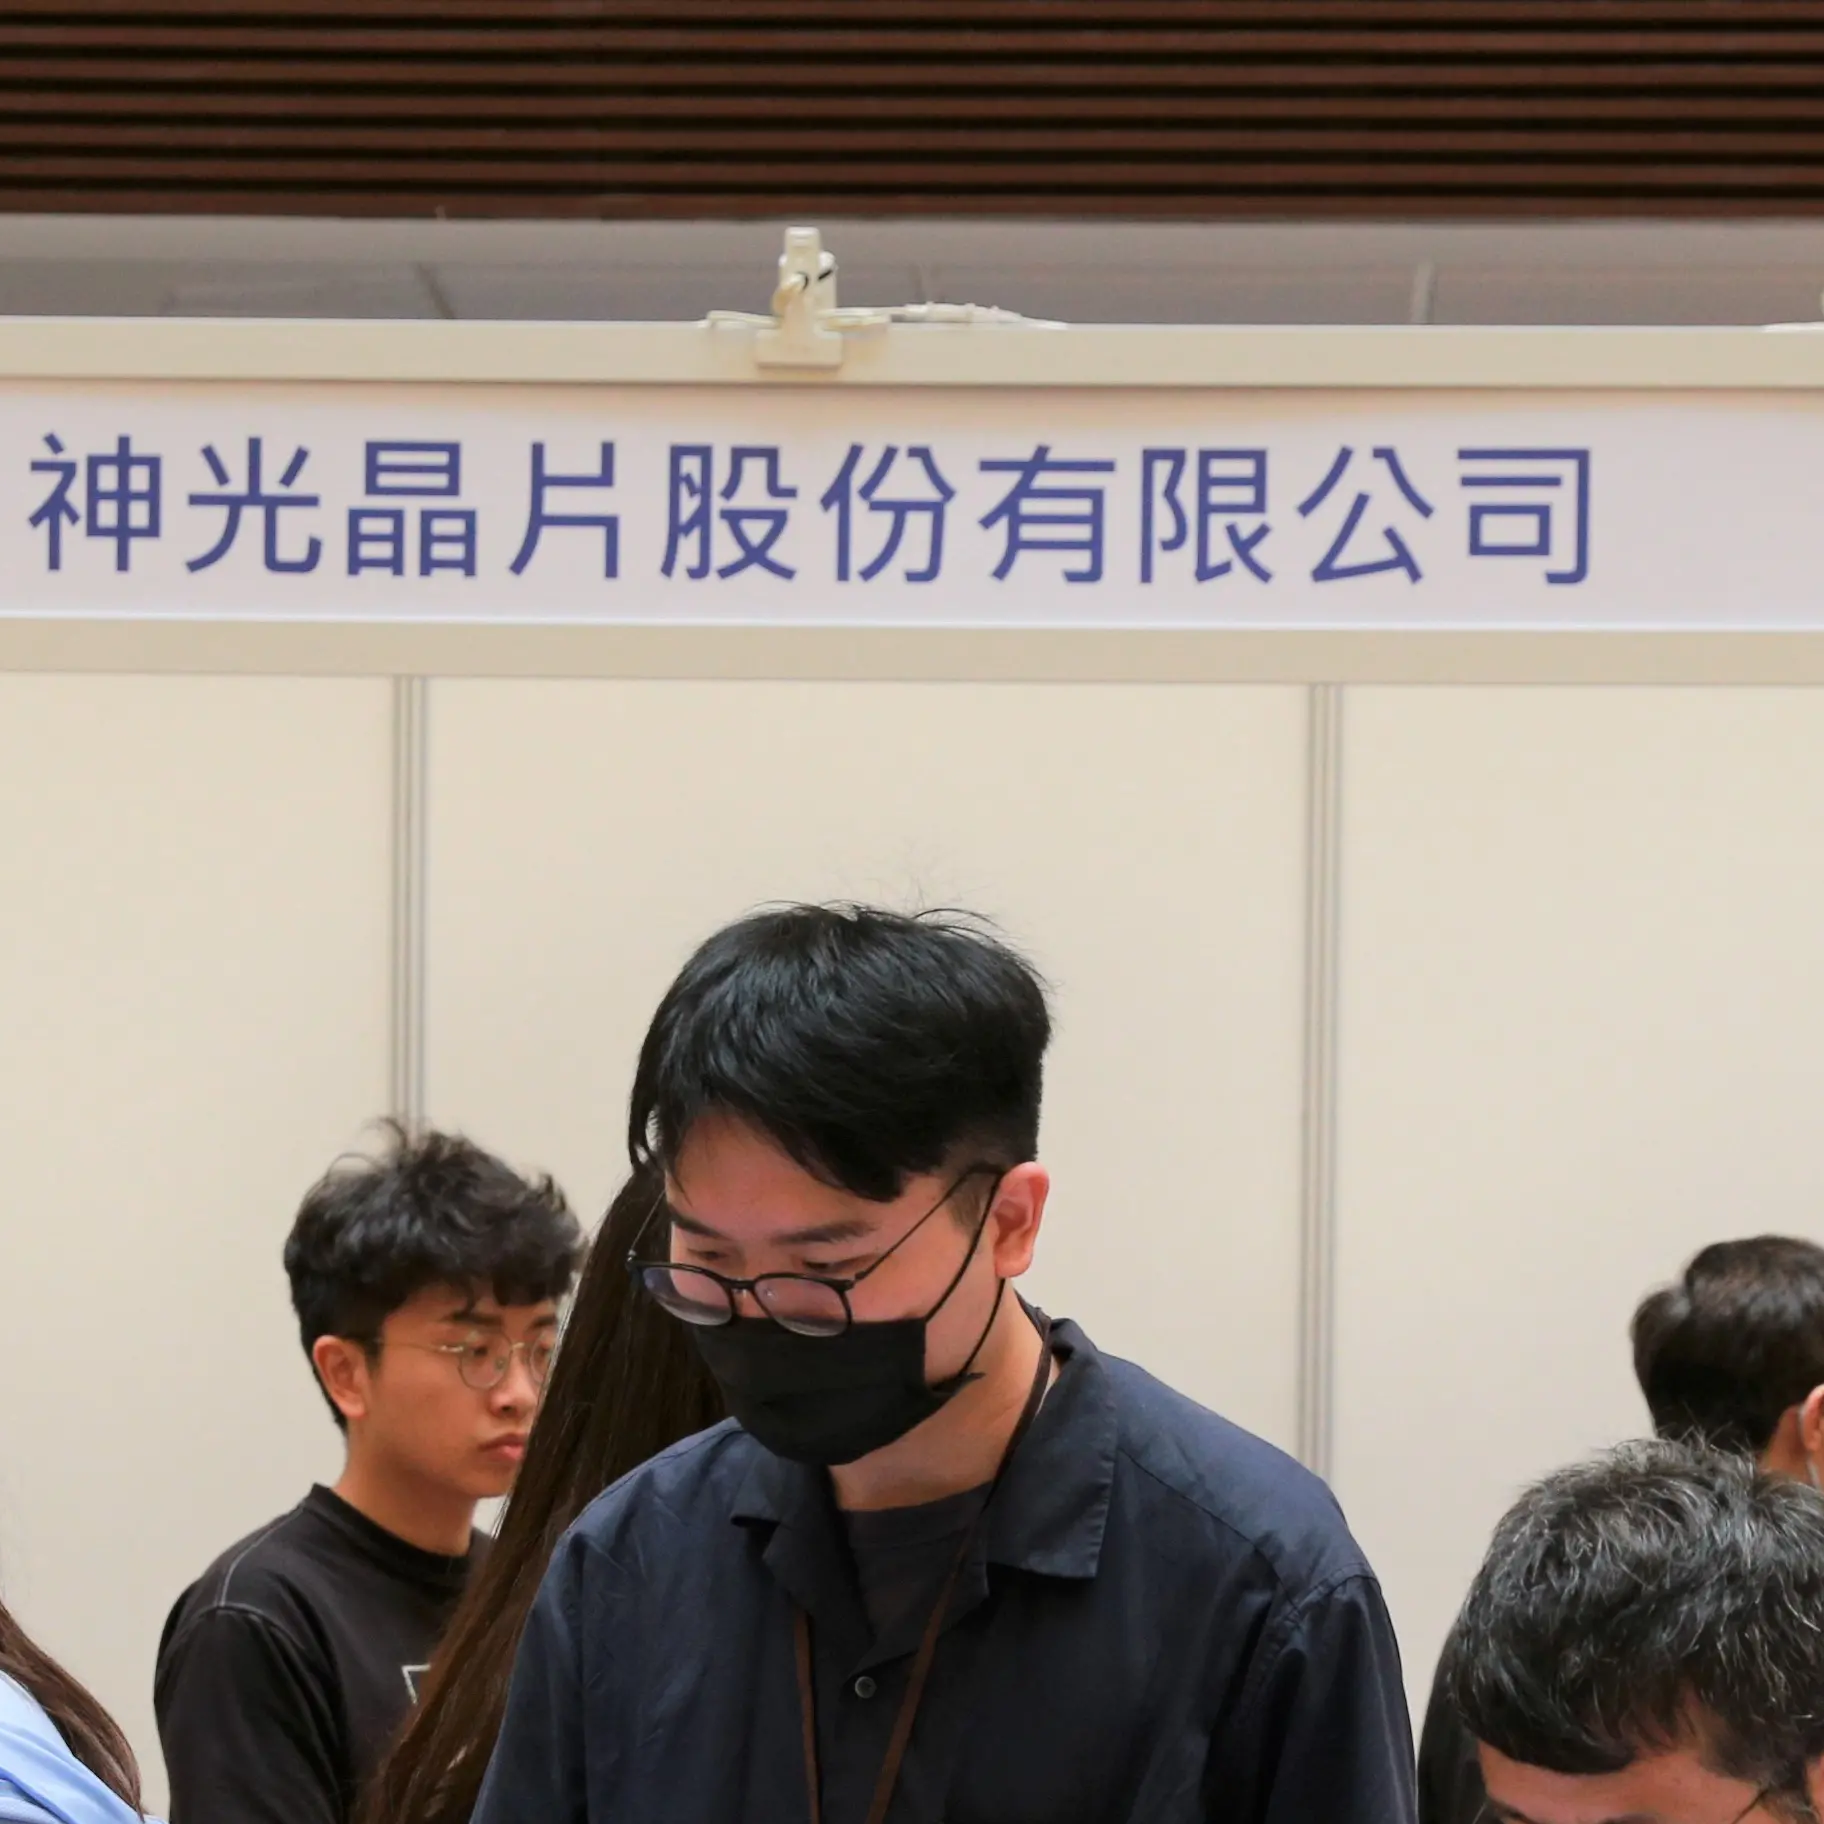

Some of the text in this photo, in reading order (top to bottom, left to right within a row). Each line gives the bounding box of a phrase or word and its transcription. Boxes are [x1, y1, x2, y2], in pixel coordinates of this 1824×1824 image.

[27, 432, 1592, 585] 神光晶片股份有限公司
